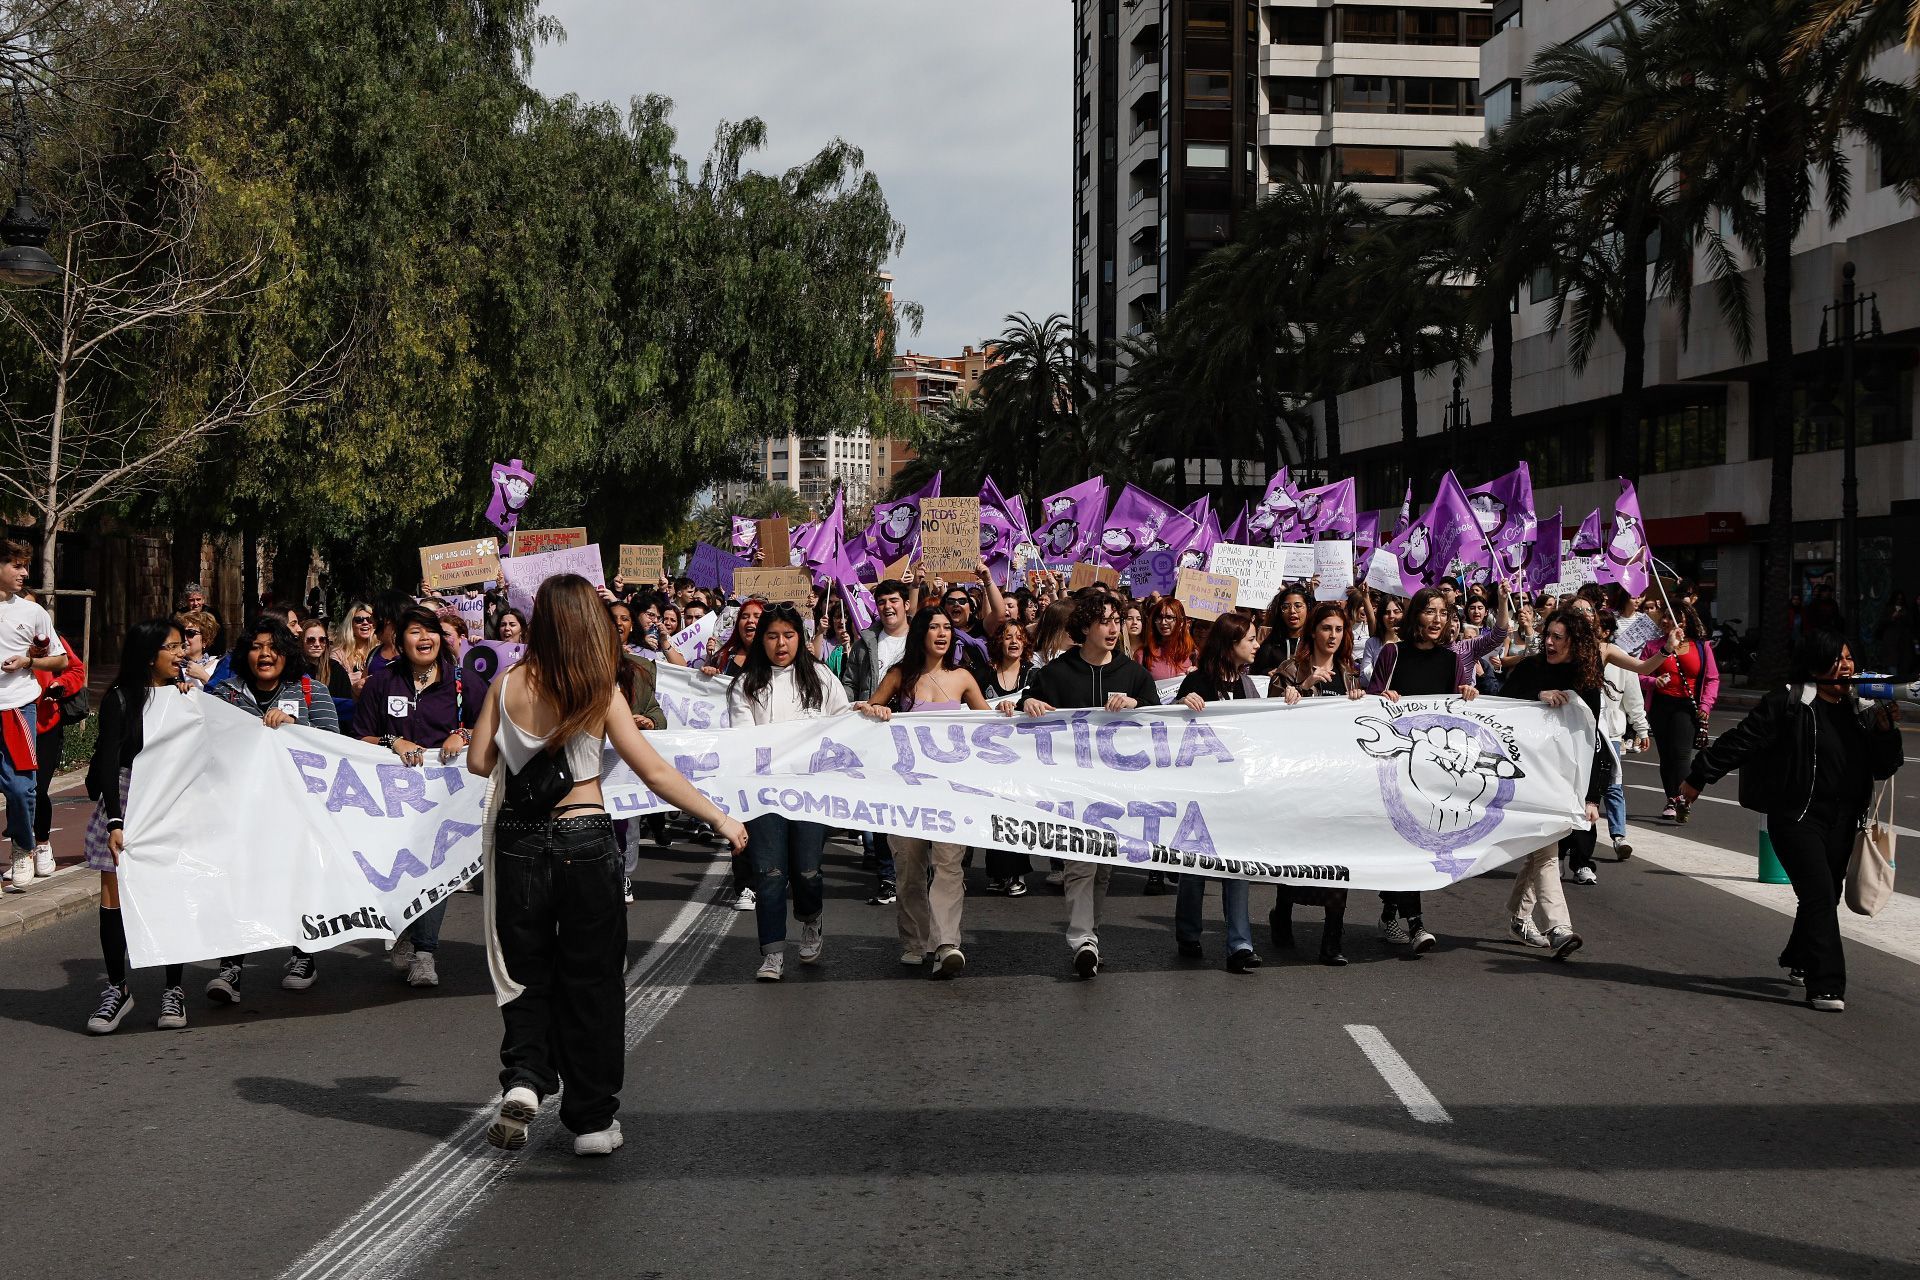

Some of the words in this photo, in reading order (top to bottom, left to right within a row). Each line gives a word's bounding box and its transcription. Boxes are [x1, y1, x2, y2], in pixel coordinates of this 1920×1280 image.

[929, 509, 957, 520] TODAS
[922, 519, 939, 532] NO
[1248, 548, 1259, 558] QUE
[1267, 551, 1276, 561] EL
[1255, 560, 1266, 569] NO
[1269, 561, 1278, 570] TE
[890, 711, 1235, 786] JUSTÍCIA
[738, 789, 749, 813] I
[757, 787, 956, 833] COMBATIVES
[991, 814, 1119, 858] ESQUERRA
